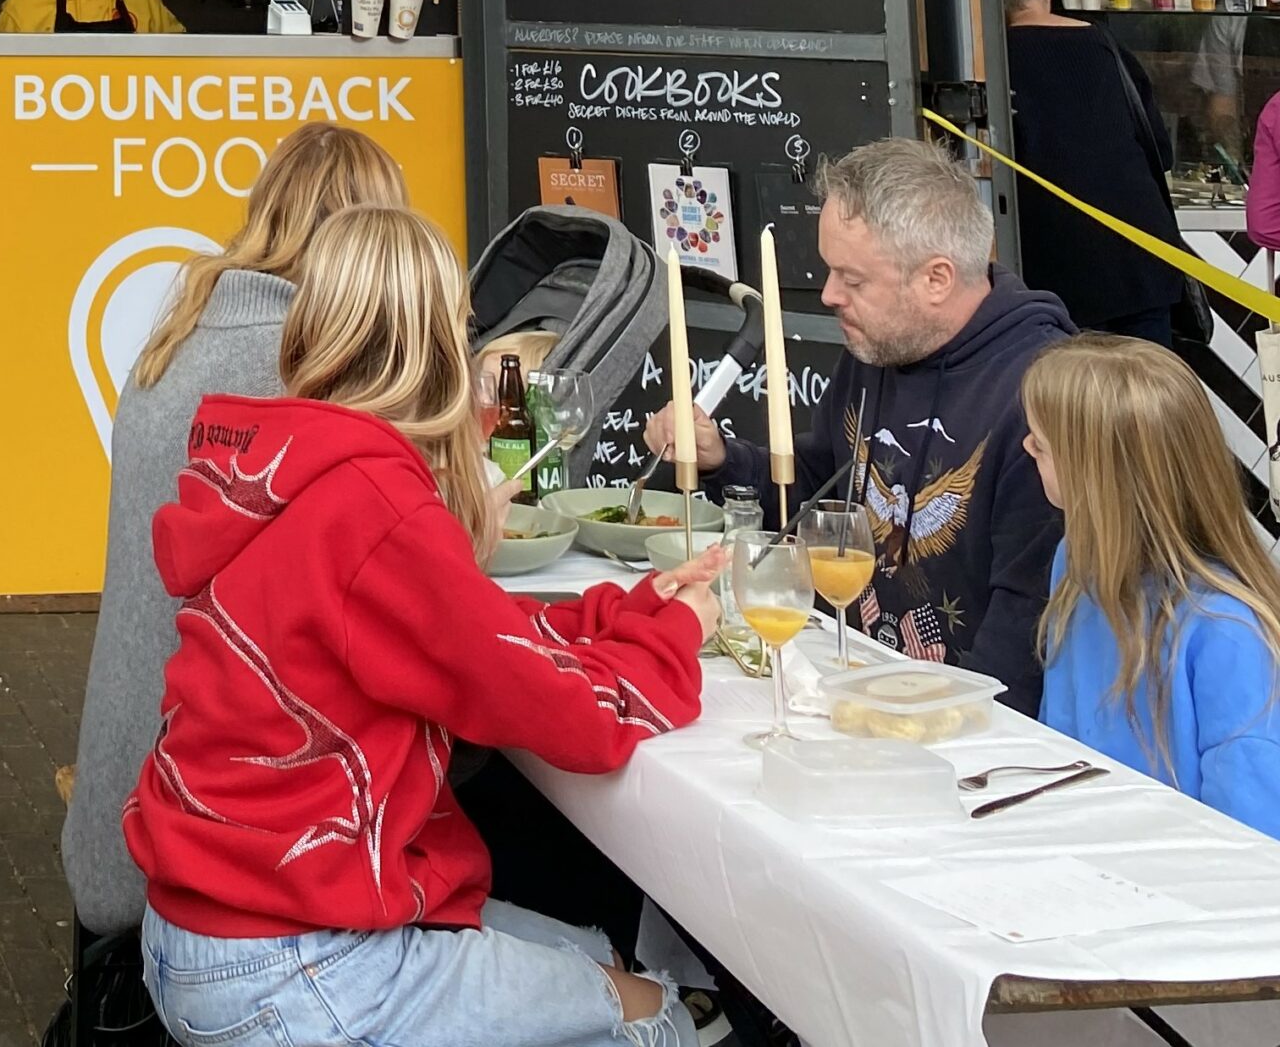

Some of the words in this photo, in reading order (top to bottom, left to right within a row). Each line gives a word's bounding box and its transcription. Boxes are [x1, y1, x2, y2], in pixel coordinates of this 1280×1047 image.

[689, 33, 725, 47] STAFF
[521, 62, 541, 75] FOR
[543, 60, 562, 74] £16
[524, 79, 543, 92] FOR
[580, 63, 782, 108] COOKBOOKS
[14, 74, 415, 121] BOUNCEBACK
[525, 95, 544, 107] FOR
[568, 102, 611, 119] SECRET
[615, 105, 657, 120] DISHES
[660, 107, 692, 122] FROM
[694, 108, 731, 123] AROUND
[733, 111, 756, 126] THE
[759, 111, 800, 128] WORLD
[113, 137, 283, 198] FOO
[550, 172, 606, 188] SECRET
[641, 351, 663, 390] A
